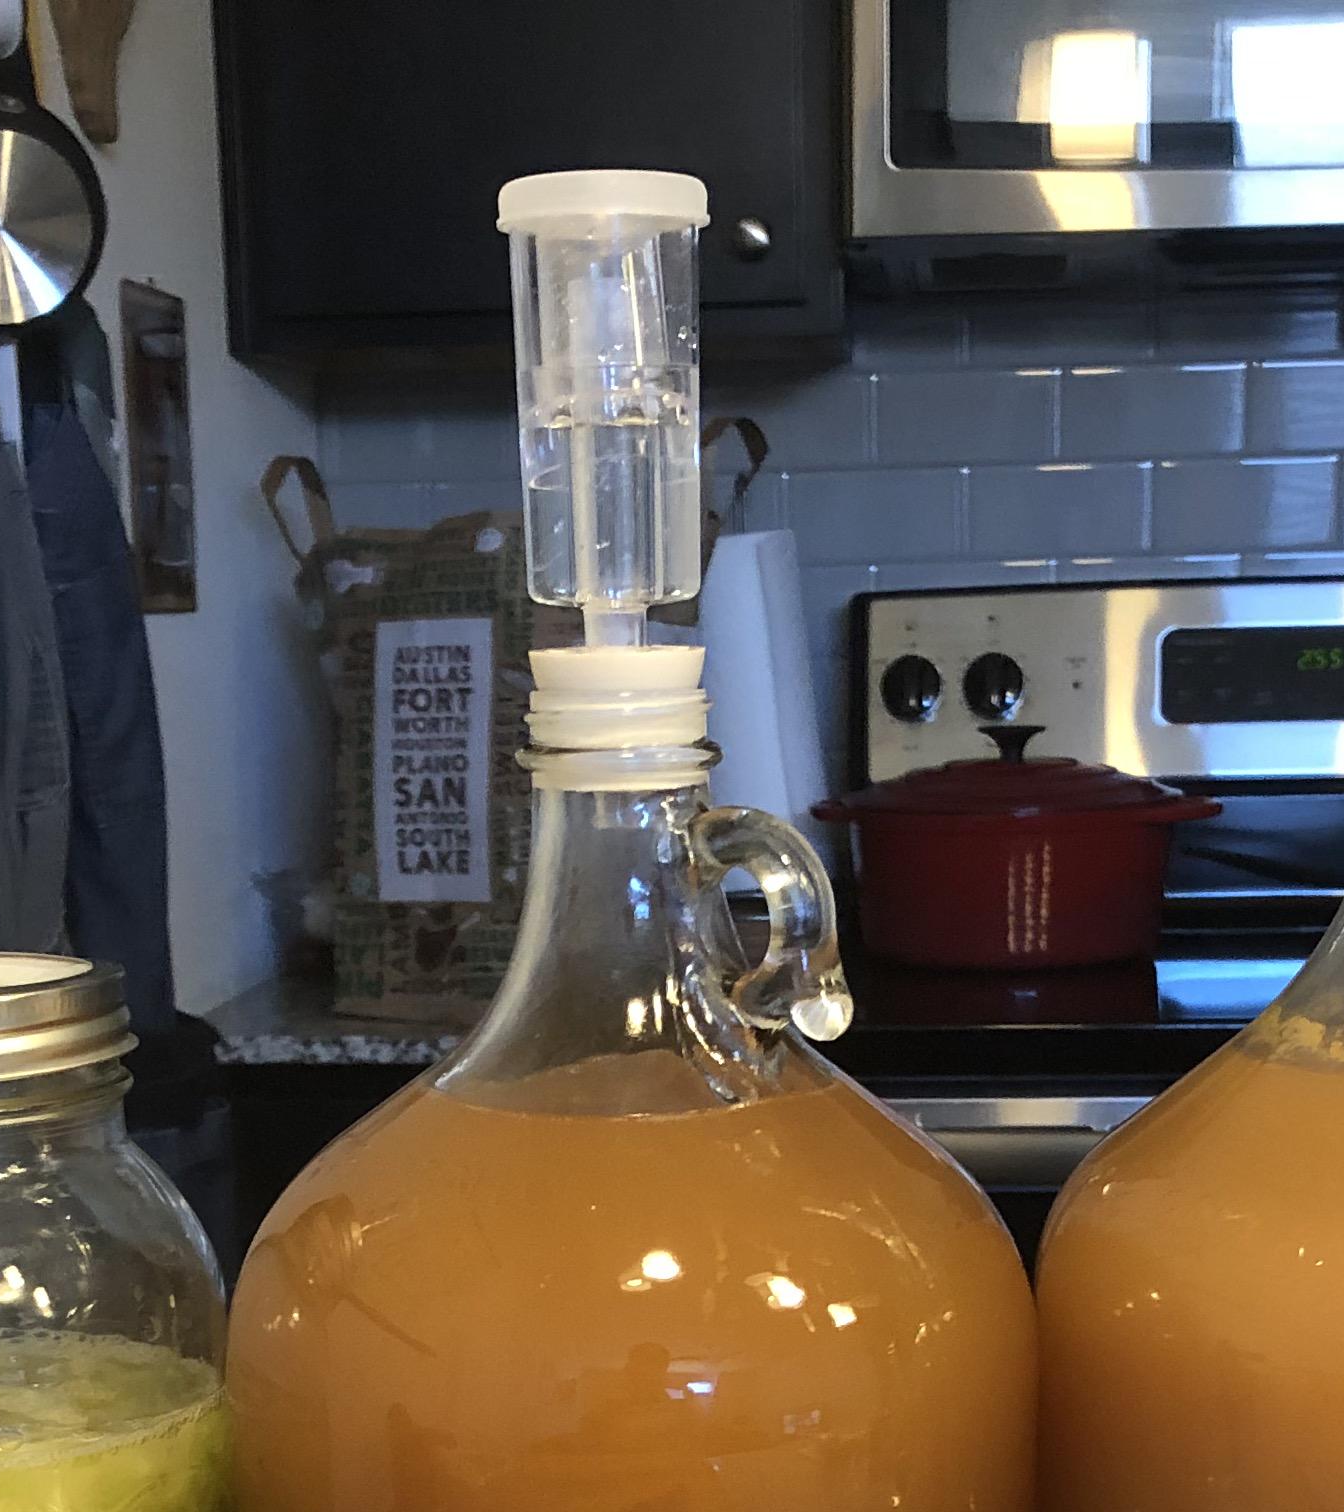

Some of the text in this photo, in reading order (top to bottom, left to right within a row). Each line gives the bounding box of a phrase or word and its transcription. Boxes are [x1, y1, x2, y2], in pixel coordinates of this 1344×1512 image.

[394, 645, 471, 664] AUSTIN
[393, 666, 471, 684] DALLAS
[392, 688, 473, 713] FORT
[393, 716, 469, 733] WORTH
[392, 754, 469, 774] PLANO
[394, 777, 467, 808] SAN
[396, 828, 471, 848] SOUTH
[397, 850, 469, 875] LAKE
